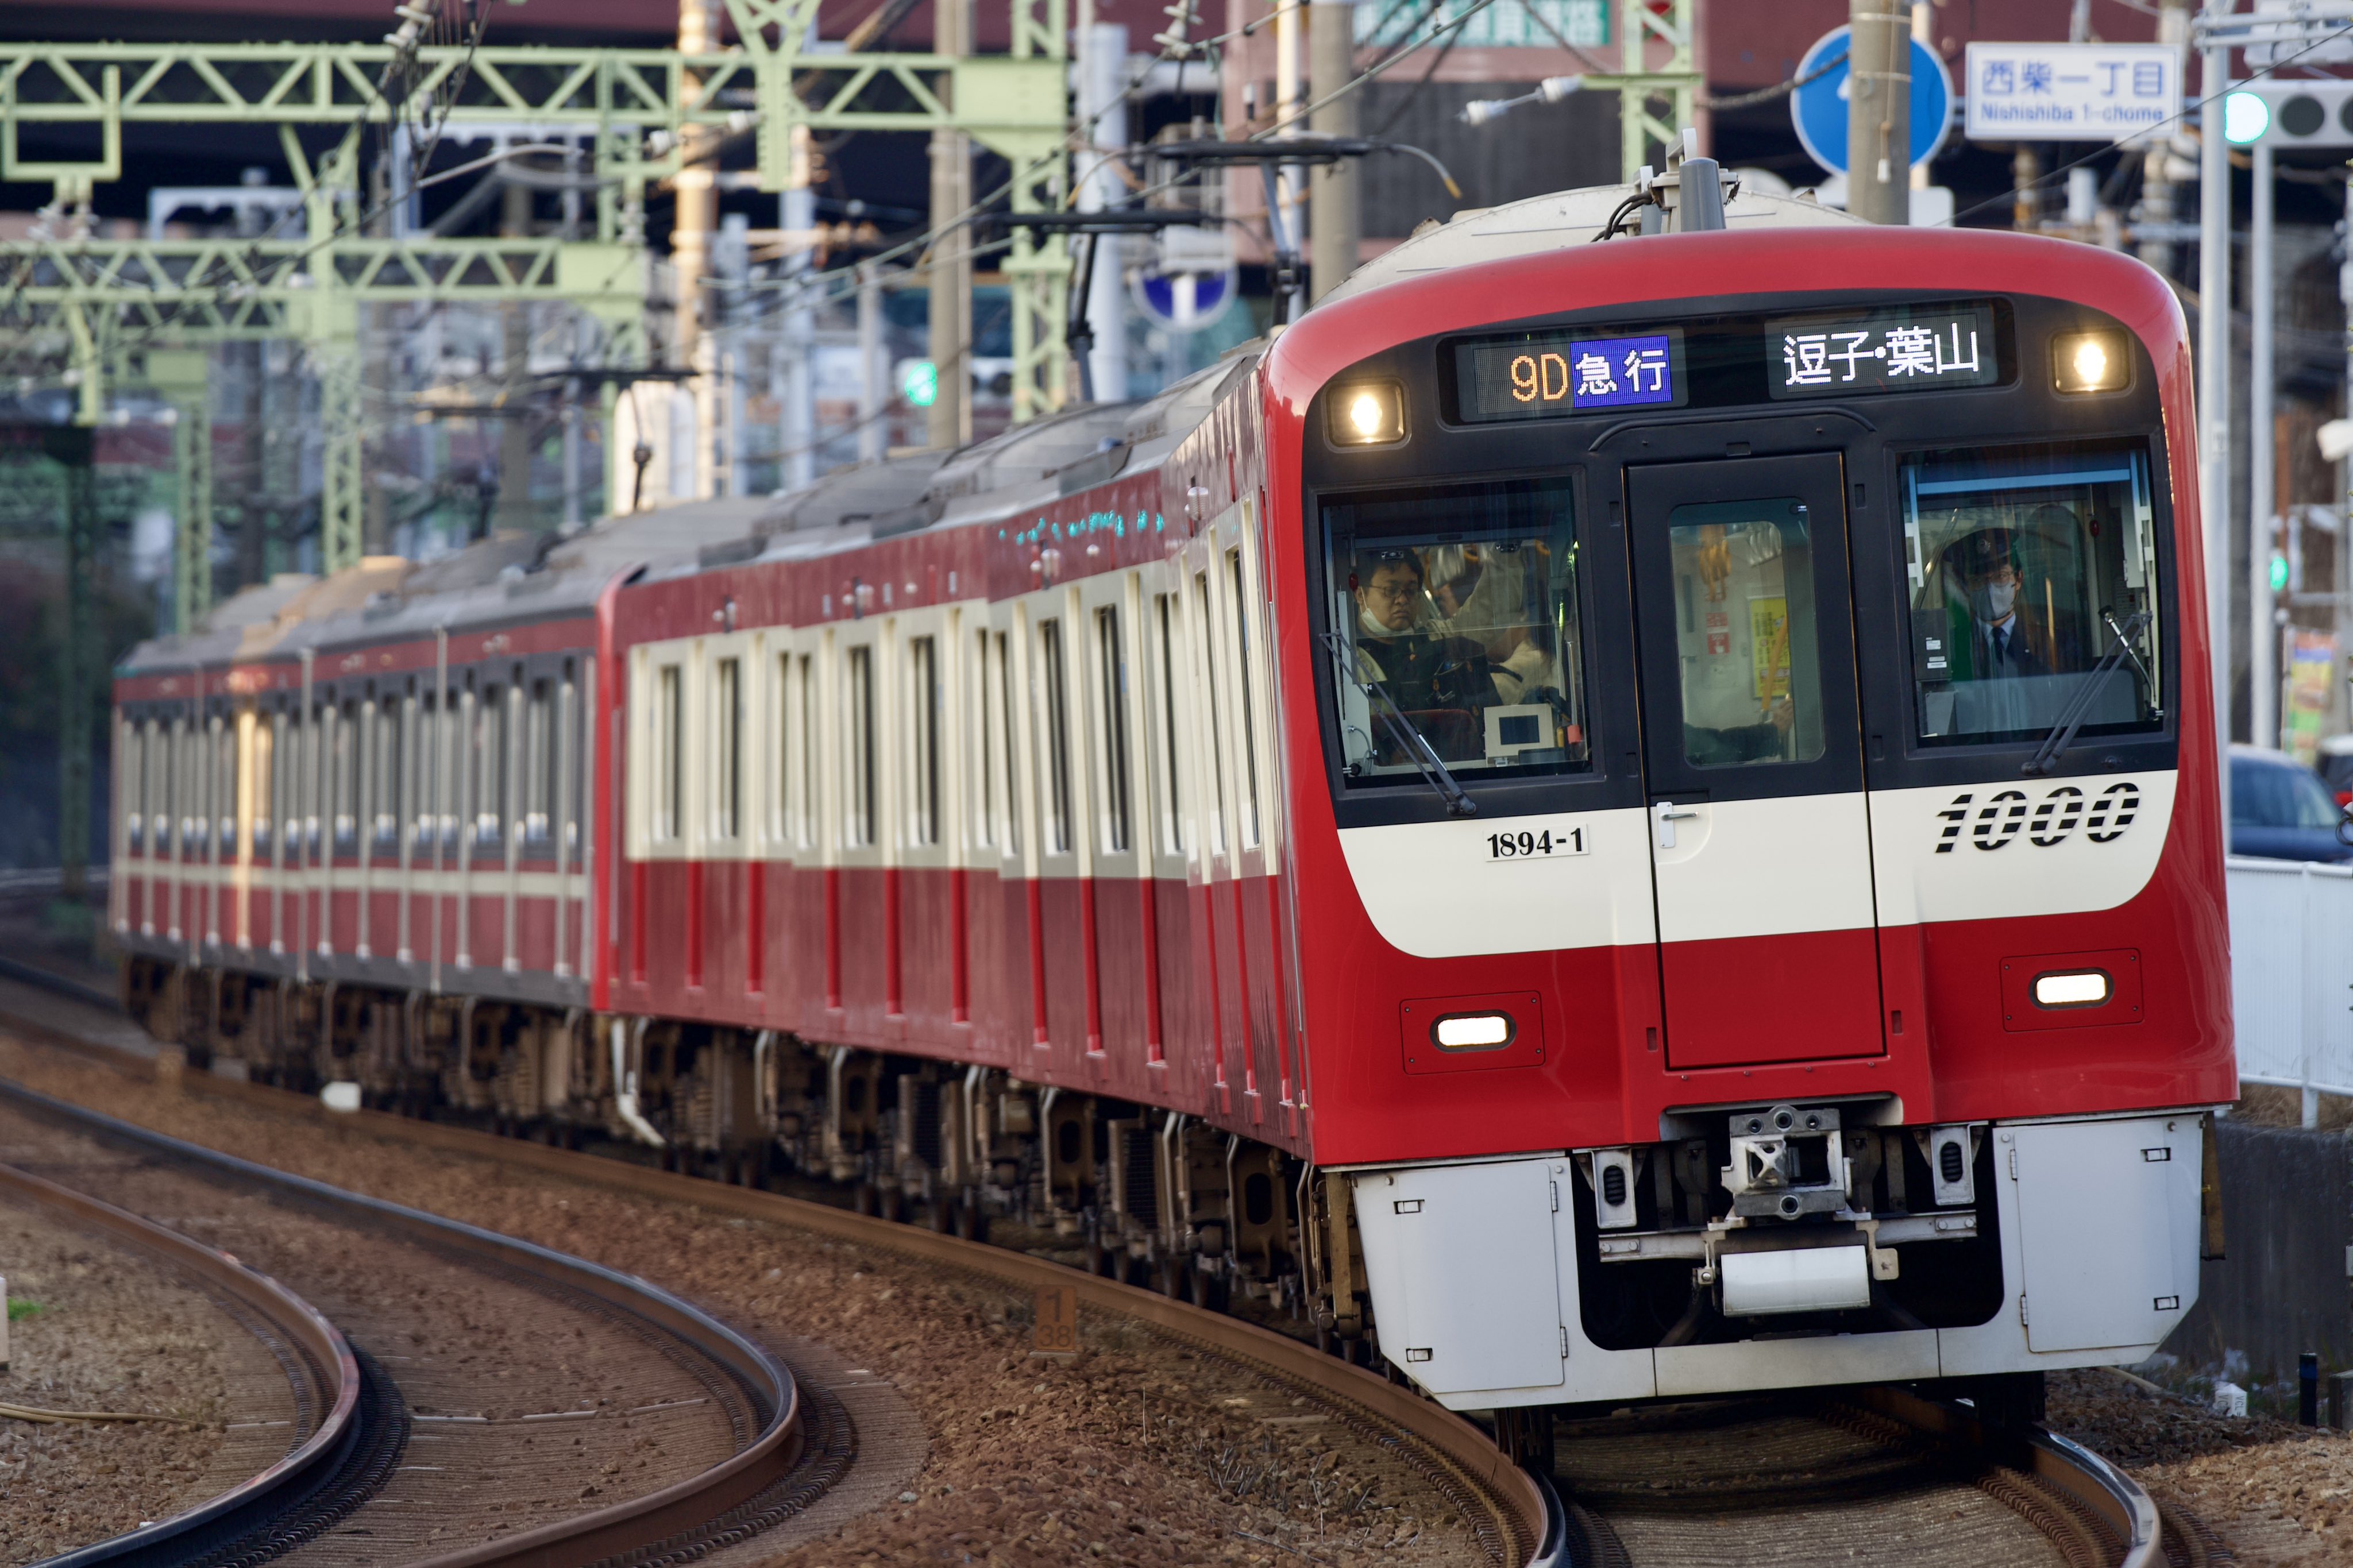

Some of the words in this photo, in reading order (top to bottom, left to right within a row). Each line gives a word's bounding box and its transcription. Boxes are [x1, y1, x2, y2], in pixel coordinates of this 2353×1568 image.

[1982, 60, 2162, 97] 西柴一丁目
[1982, 103, 2073, 122] Nishishiba
[2082, 103, 2163, 122] 1-chome
[1511, 353, 1568, 401] 9D
[1575, 349, 1667, 396] 急行
[1935, 782, 2140, 853] 1000
[1487, 828, 1582, 858] 1894-1
[1046, 1288, 1062, 1322] 1
[1039, 1324, 1071, 1347] 38
